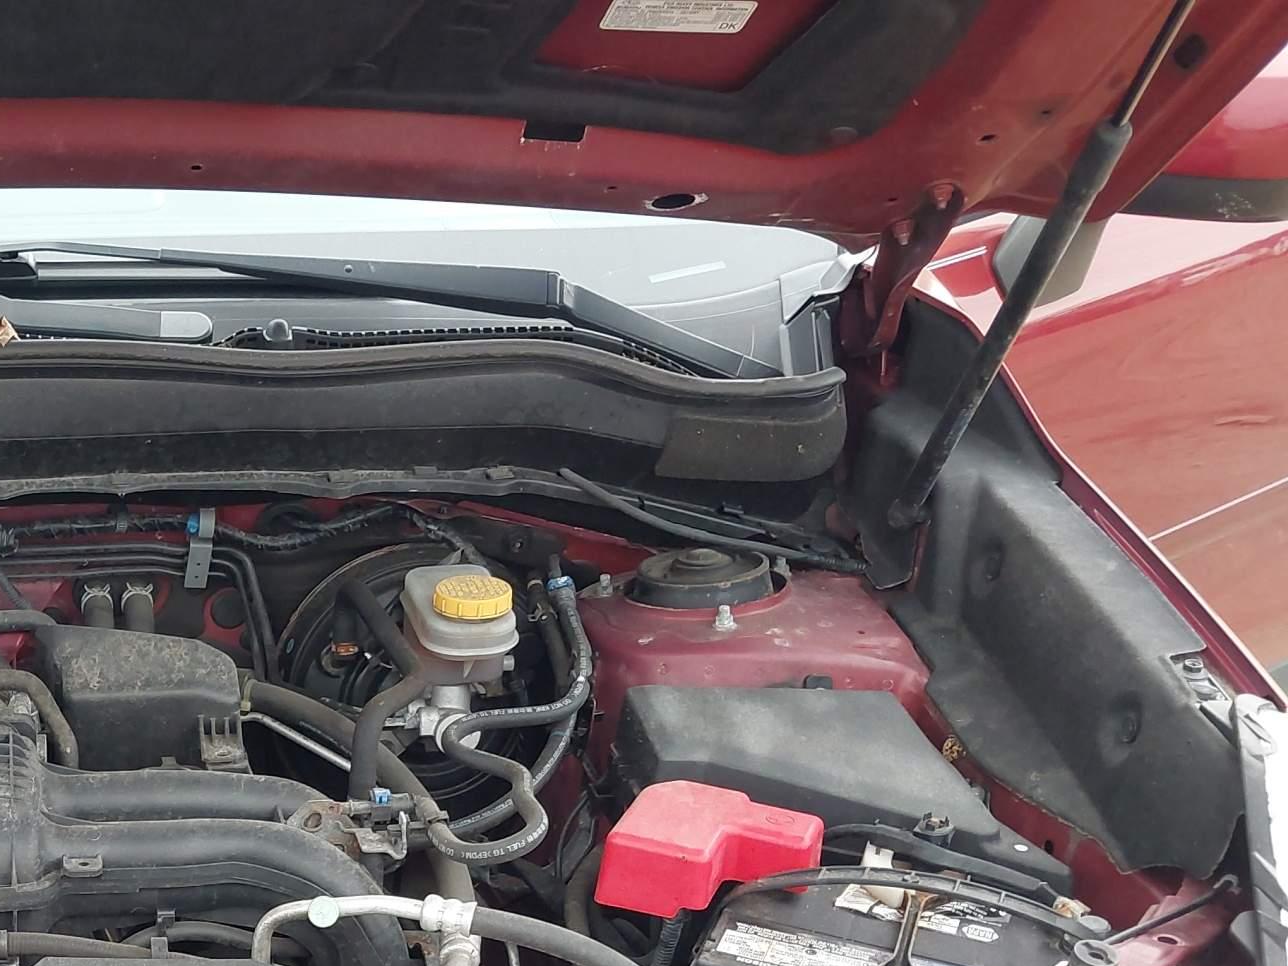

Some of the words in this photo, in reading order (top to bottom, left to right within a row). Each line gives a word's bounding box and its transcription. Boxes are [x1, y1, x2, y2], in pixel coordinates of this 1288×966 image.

[718, 22, 738, 30] DK
[507, 839, 526, 852] FUEL
[493, 848, 505, 857] TG
